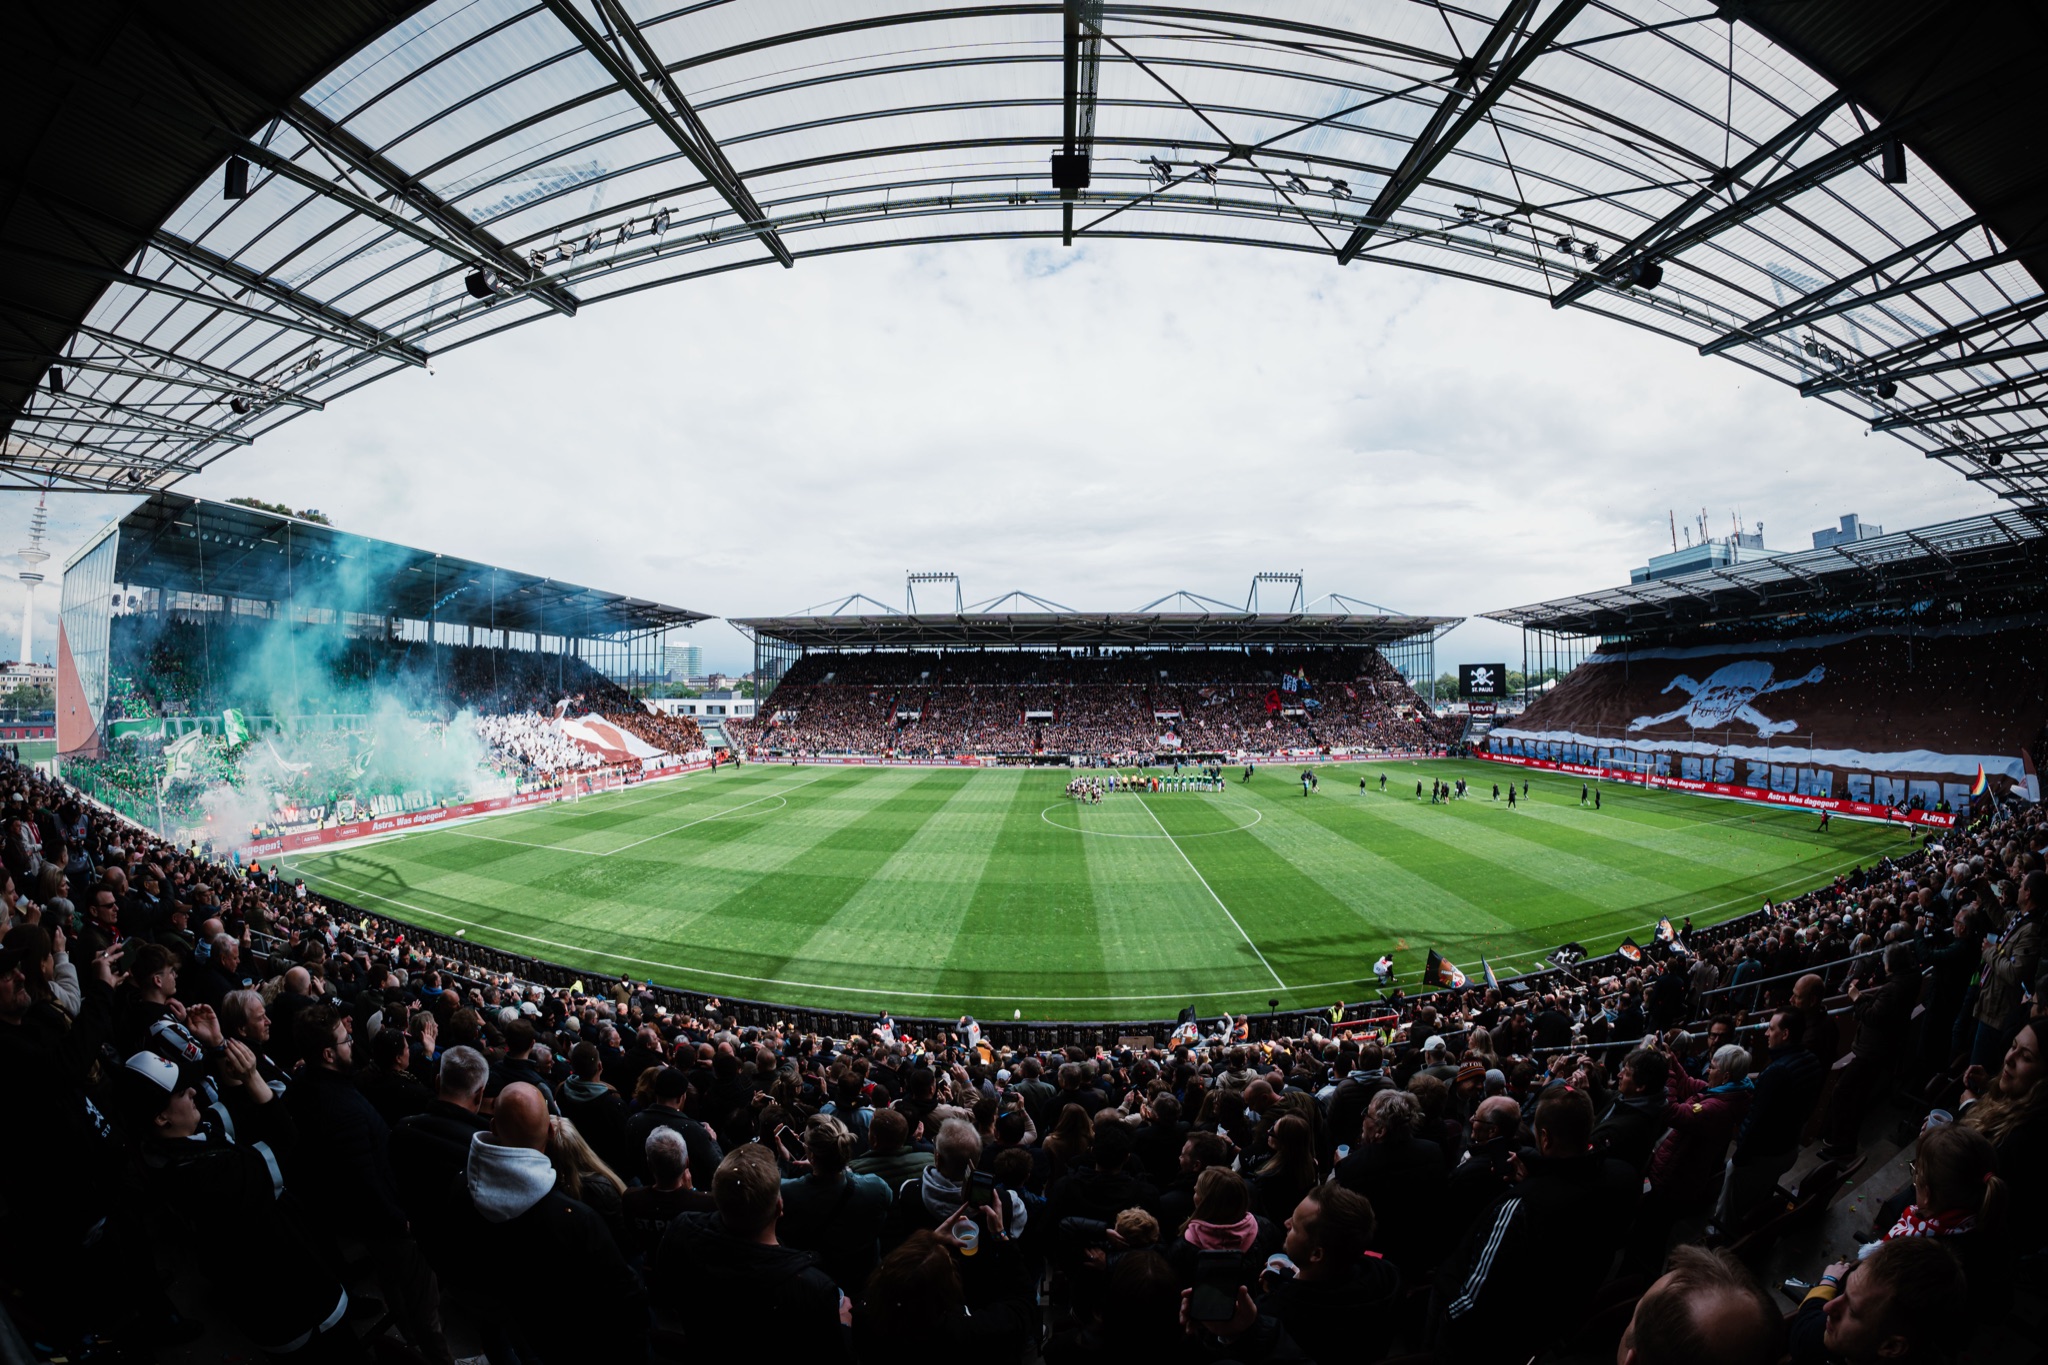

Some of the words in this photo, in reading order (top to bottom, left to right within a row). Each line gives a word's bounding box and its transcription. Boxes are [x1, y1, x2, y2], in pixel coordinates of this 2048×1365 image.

[1283, 673, 1298, 685] FCK
[1282, 682, 1297, 693] AFD
[1681, 756, 1735, 783] BIS
[1746, 760, 1834, 798] ZUM
[1847, 773, 1970, 817] ENDE
[1767, 792, 1787, 802] Astra.
[1788, 795, 1803, 804] Was
[1804, 797, 1839, 809] dagegen?
[309, 805, 326, 819] 07
[372, 821, 395, 832] Astra.
[396, 817, 412, 827] Was
[413, 810, 447, 823] dagegen?
